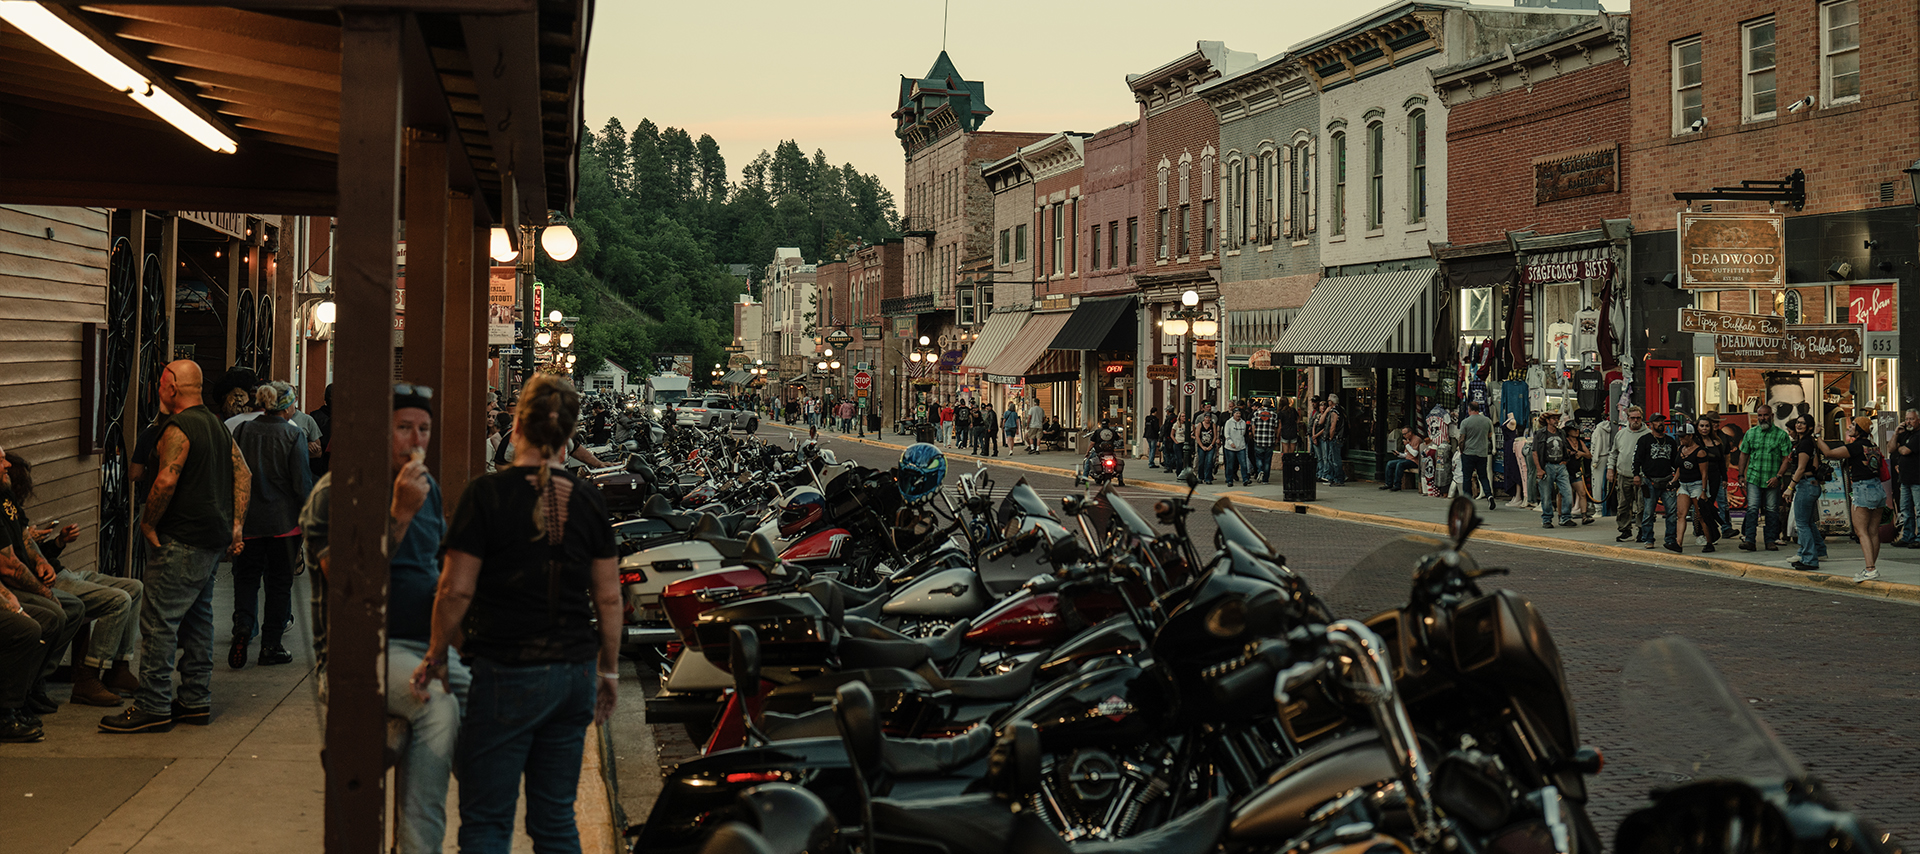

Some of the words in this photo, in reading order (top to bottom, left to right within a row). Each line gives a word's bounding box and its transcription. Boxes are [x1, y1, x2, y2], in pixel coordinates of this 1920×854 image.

[1692, 253, 1775, 265] DEADWOOD
[1528, 263, 1578, 280] STAGECOACH
[1584, 260, 1608, 277] GIFTS
[1685, 316, 1694, 327] &
[1693, 311, 1718, 333] Tipsy
[1719, 315, 1756, 332] Buffalo
[1758, 320, 1779, 334] Bar
[1721, 334, 1779, 348] DEADWOOD
[1787, 333, 1806, 359] Tipsy
[1806, 336, 1836, 355] Buffalo
[1836, 338, 1854, 354] Bar
[1873, 340, 1891, 351] 653
[1322, 355, 1351, 364] MERCANTILE
[1106, 365, 1123, 373] OPEN
